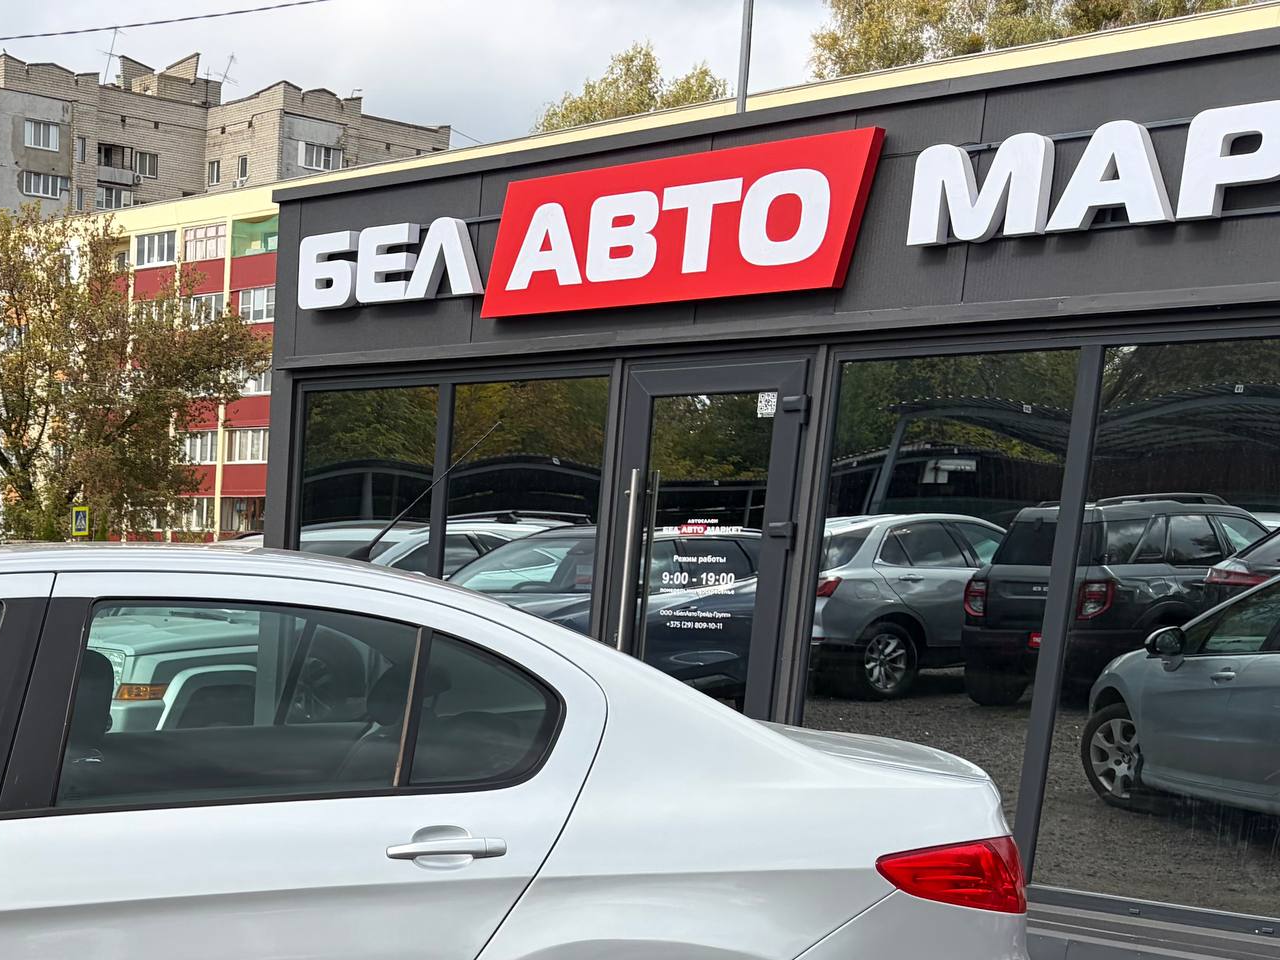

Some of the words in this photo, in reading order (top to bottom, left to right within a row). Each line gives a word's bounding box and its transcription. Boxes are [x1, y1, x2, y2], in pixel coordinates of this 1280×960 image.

[298, 215, 483, 310] БЕЛ
[505, 167, 831, 291] АВТО
[907, 99, 1280, 246] МАР
[681, 526, 704, 534] АВТО
[673, 555, 697, 563] Режим
[698, 555, 726, 564] работы
[662, 571, 688, 585] 9:00
[700, 572, 735, 586] 19:00
[666, 620, 680, 628] +375
[681, 620, 694, 629] (29)
